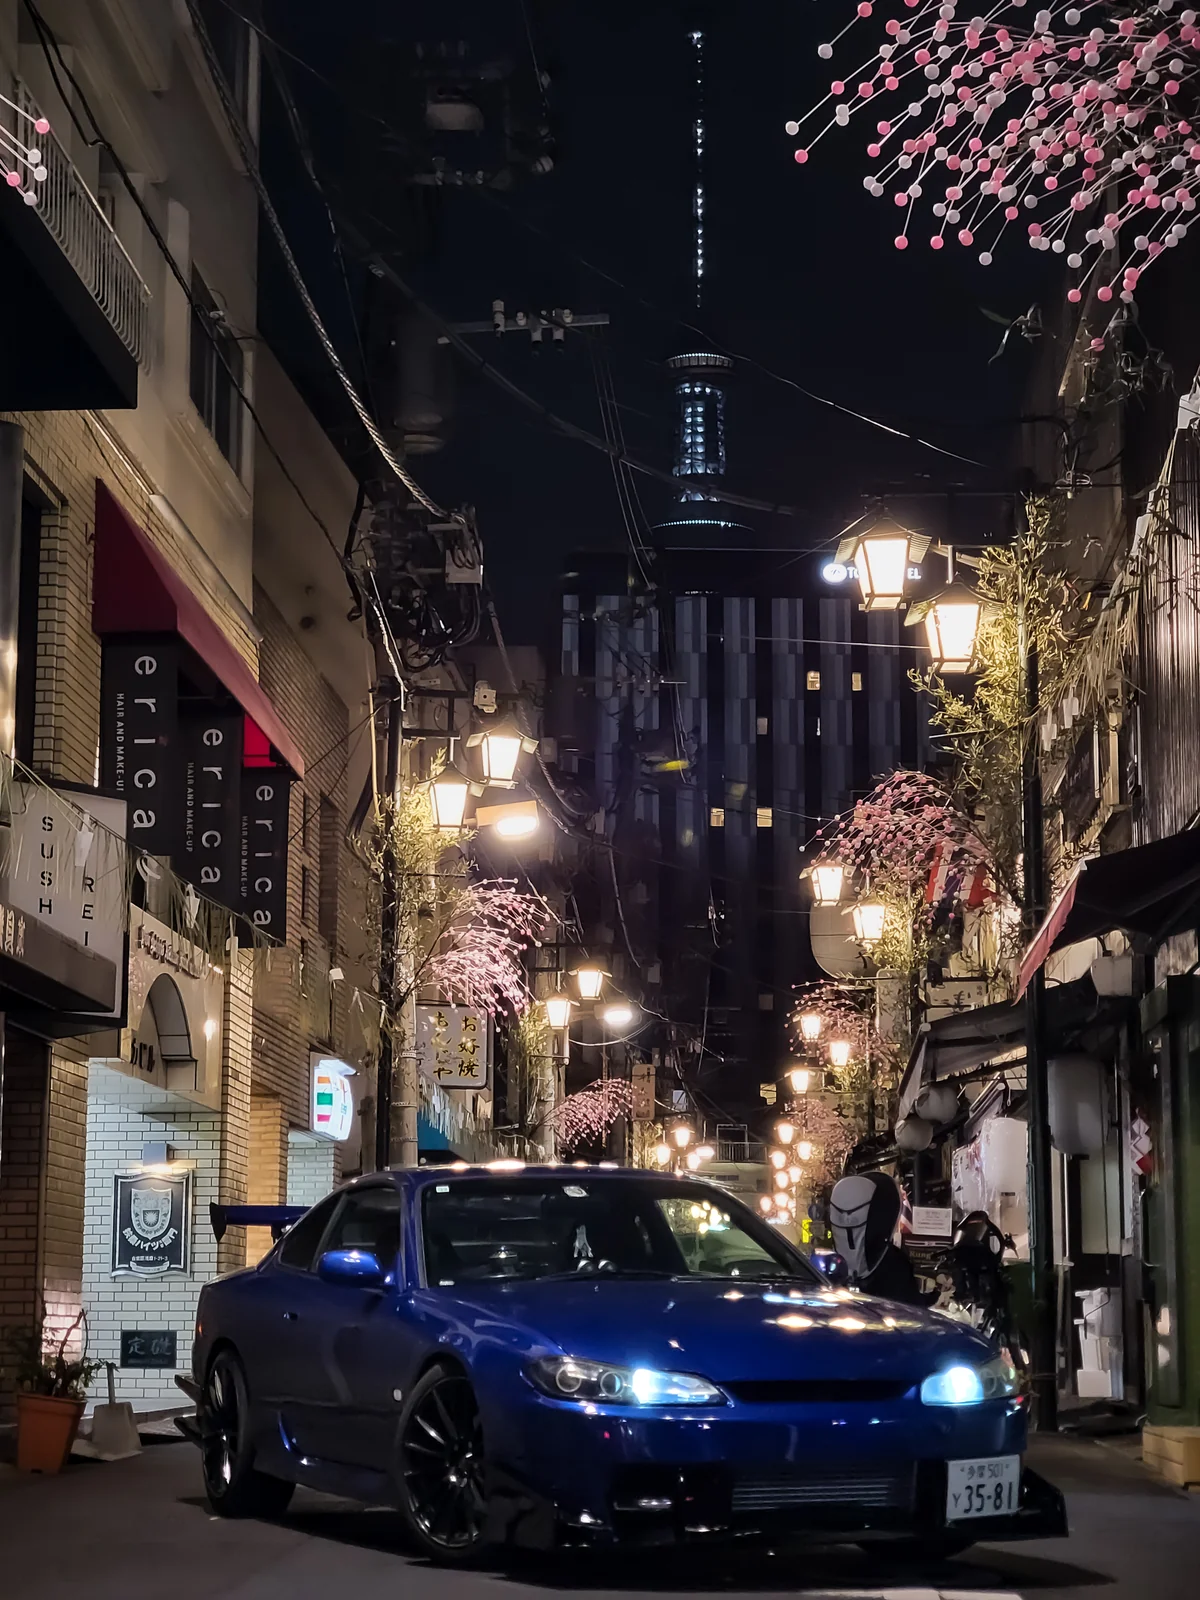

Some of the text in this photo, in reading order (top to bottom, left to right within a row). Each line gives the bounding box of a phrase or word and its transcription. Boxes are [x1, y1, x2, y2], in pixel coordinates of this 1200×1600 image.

[116, 692, 125, 719] HAIR
[116, 720, 125, 743] AND
[132, 655, 158, 829] erica
[185, 762, 195, 853] HAIR AND MAKE-UP
[200, 728, 224, 884] erica
[241, 815, 249, 836] HAIR
[253, 785, 274, 926] erica
[240, 858, 248, 898] MAKE-UP
[952, 1482, 1013, 1514] Y 35-81
